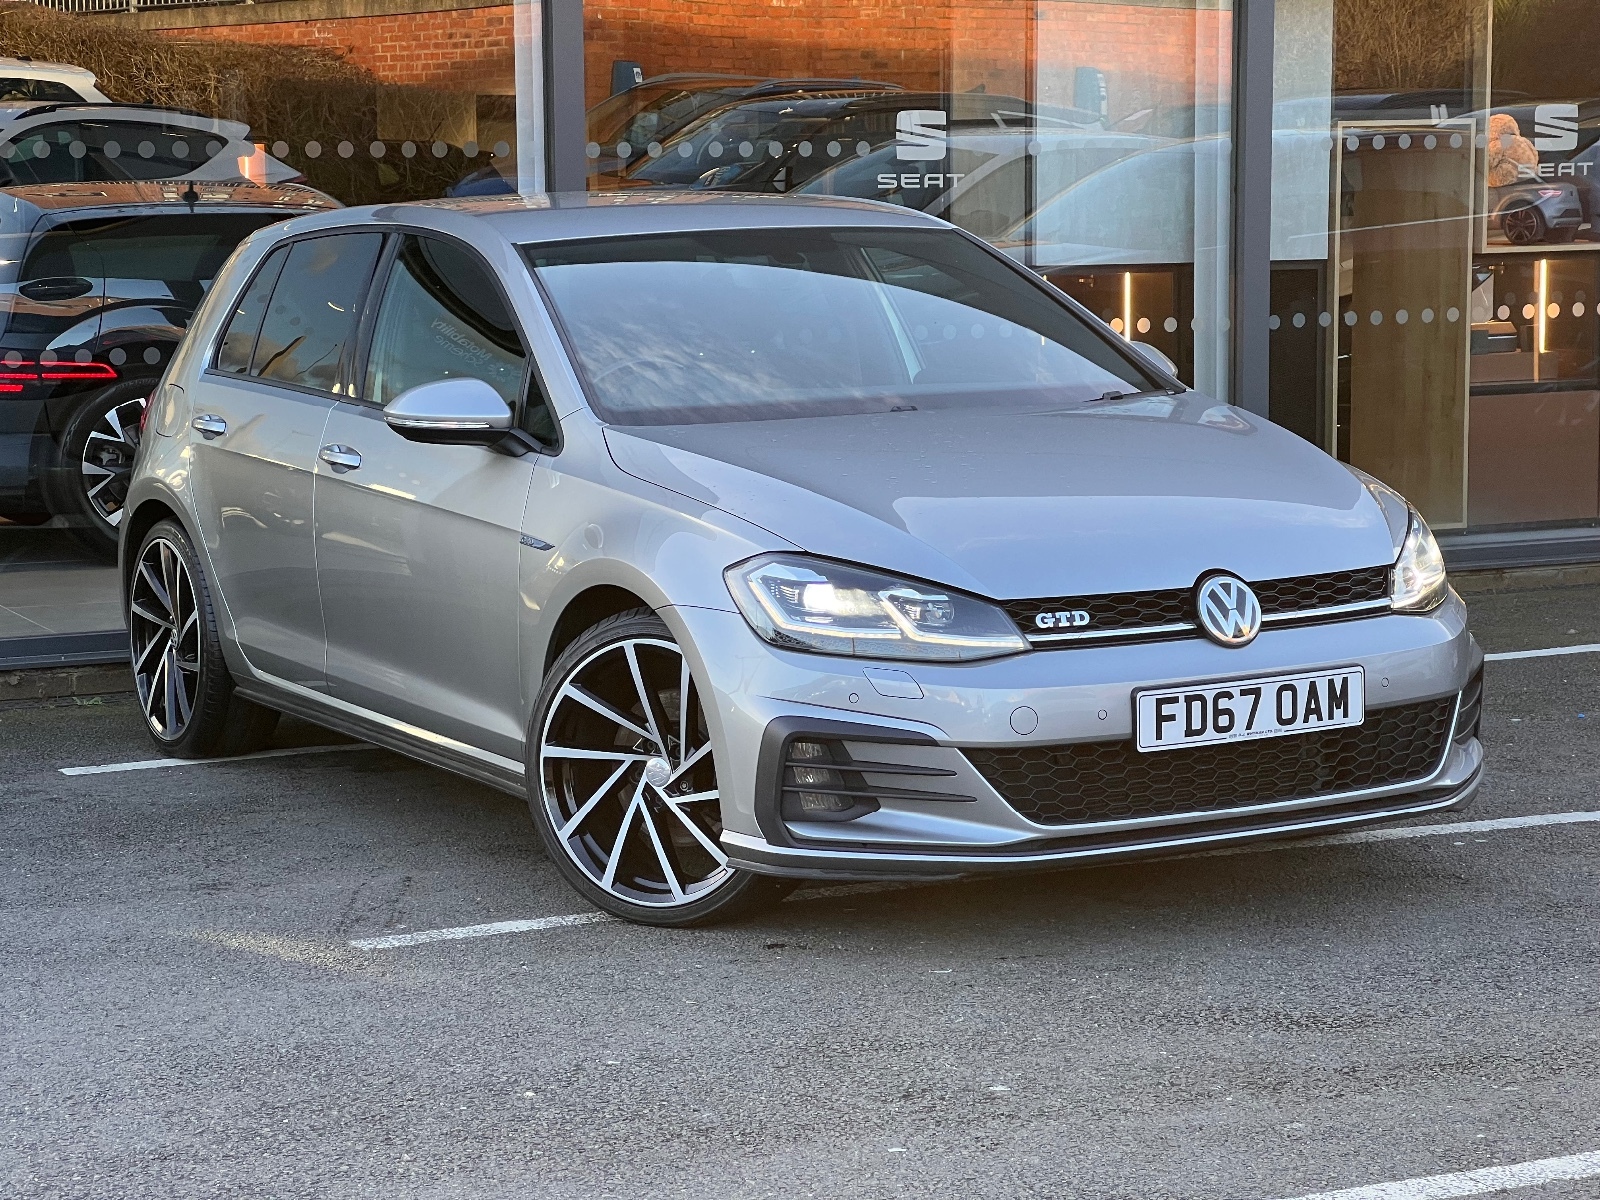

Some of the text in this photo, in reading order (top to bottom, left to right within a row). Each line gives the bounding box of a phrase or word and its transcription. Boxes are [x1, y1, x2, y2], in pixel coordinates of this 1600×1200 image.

[1517, 162, 1594, 178] SEAT
[877, 173, 965, 188] SEAT
[1035, 610, 1090, 629] GTD
[1155, 676, 1350, 741] FD67 OAM
